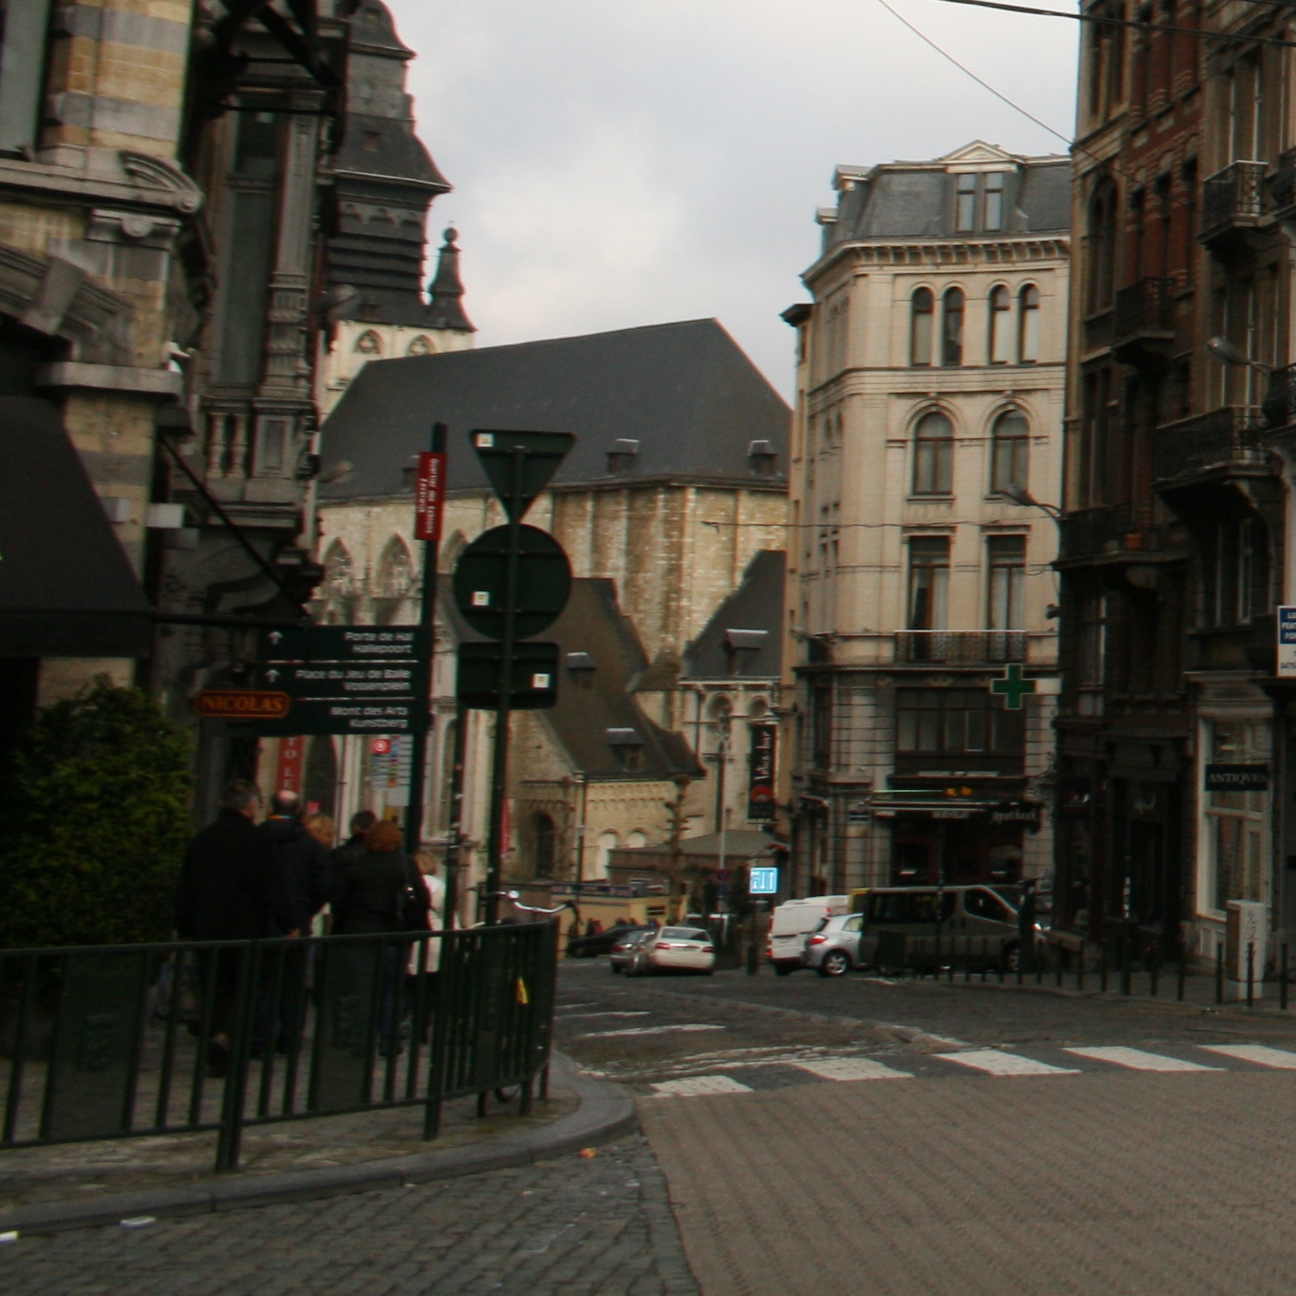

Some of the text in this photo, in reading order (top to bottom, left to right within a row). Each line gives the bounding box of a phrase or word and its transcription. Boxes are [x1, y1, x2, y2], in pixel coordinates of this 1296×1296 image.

[344, 631, 414, 642] Porte de Hal
[294, 669, 326, 680] Place
[328, 669, 344, 680] du
[345, 669, 366, 680] Jeu
[367, 669, 382, 680] de
[201, 695, 285, 712] NICOLAS
[329, 706, 409, 717] Mont des Arts
